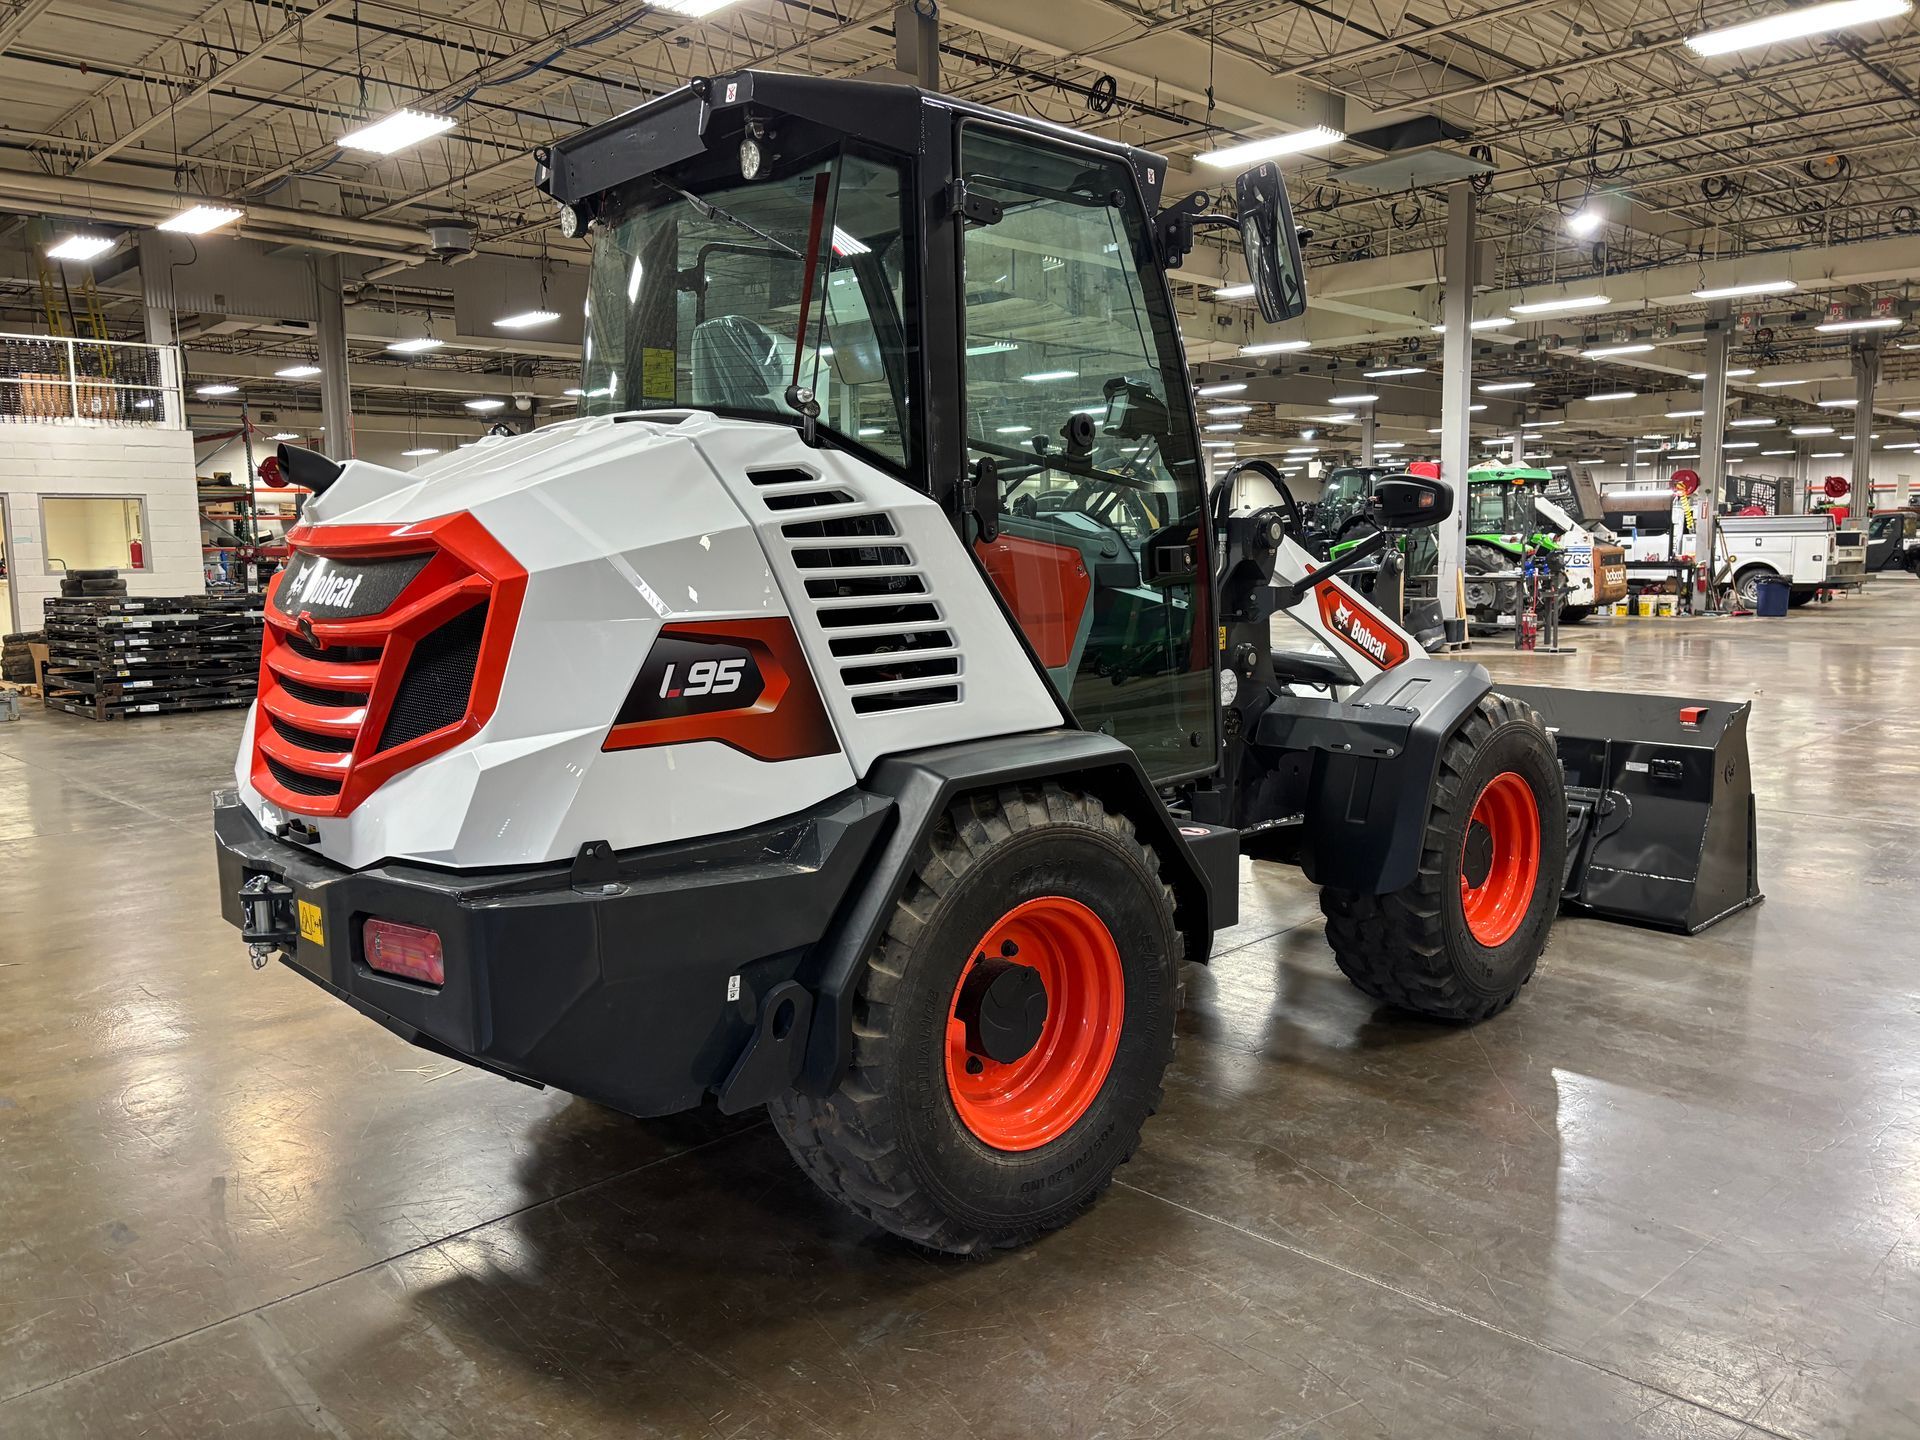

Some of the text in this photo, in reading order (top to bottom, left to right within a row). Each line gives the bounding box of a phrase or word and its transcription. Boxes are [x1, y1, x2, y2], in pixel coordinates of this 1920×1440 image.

[1829, 307, 1843, 316] 103
[1877, 303, 1892, 312] 105
[1740, 316, 1751, 325] 99
[1616, 329, 1627, 338] 93
[1656, 326, 1667, 335] 95
[1564, 553, 1592, 565] 763
[1350, 618, 1387, 662] Bobcat
